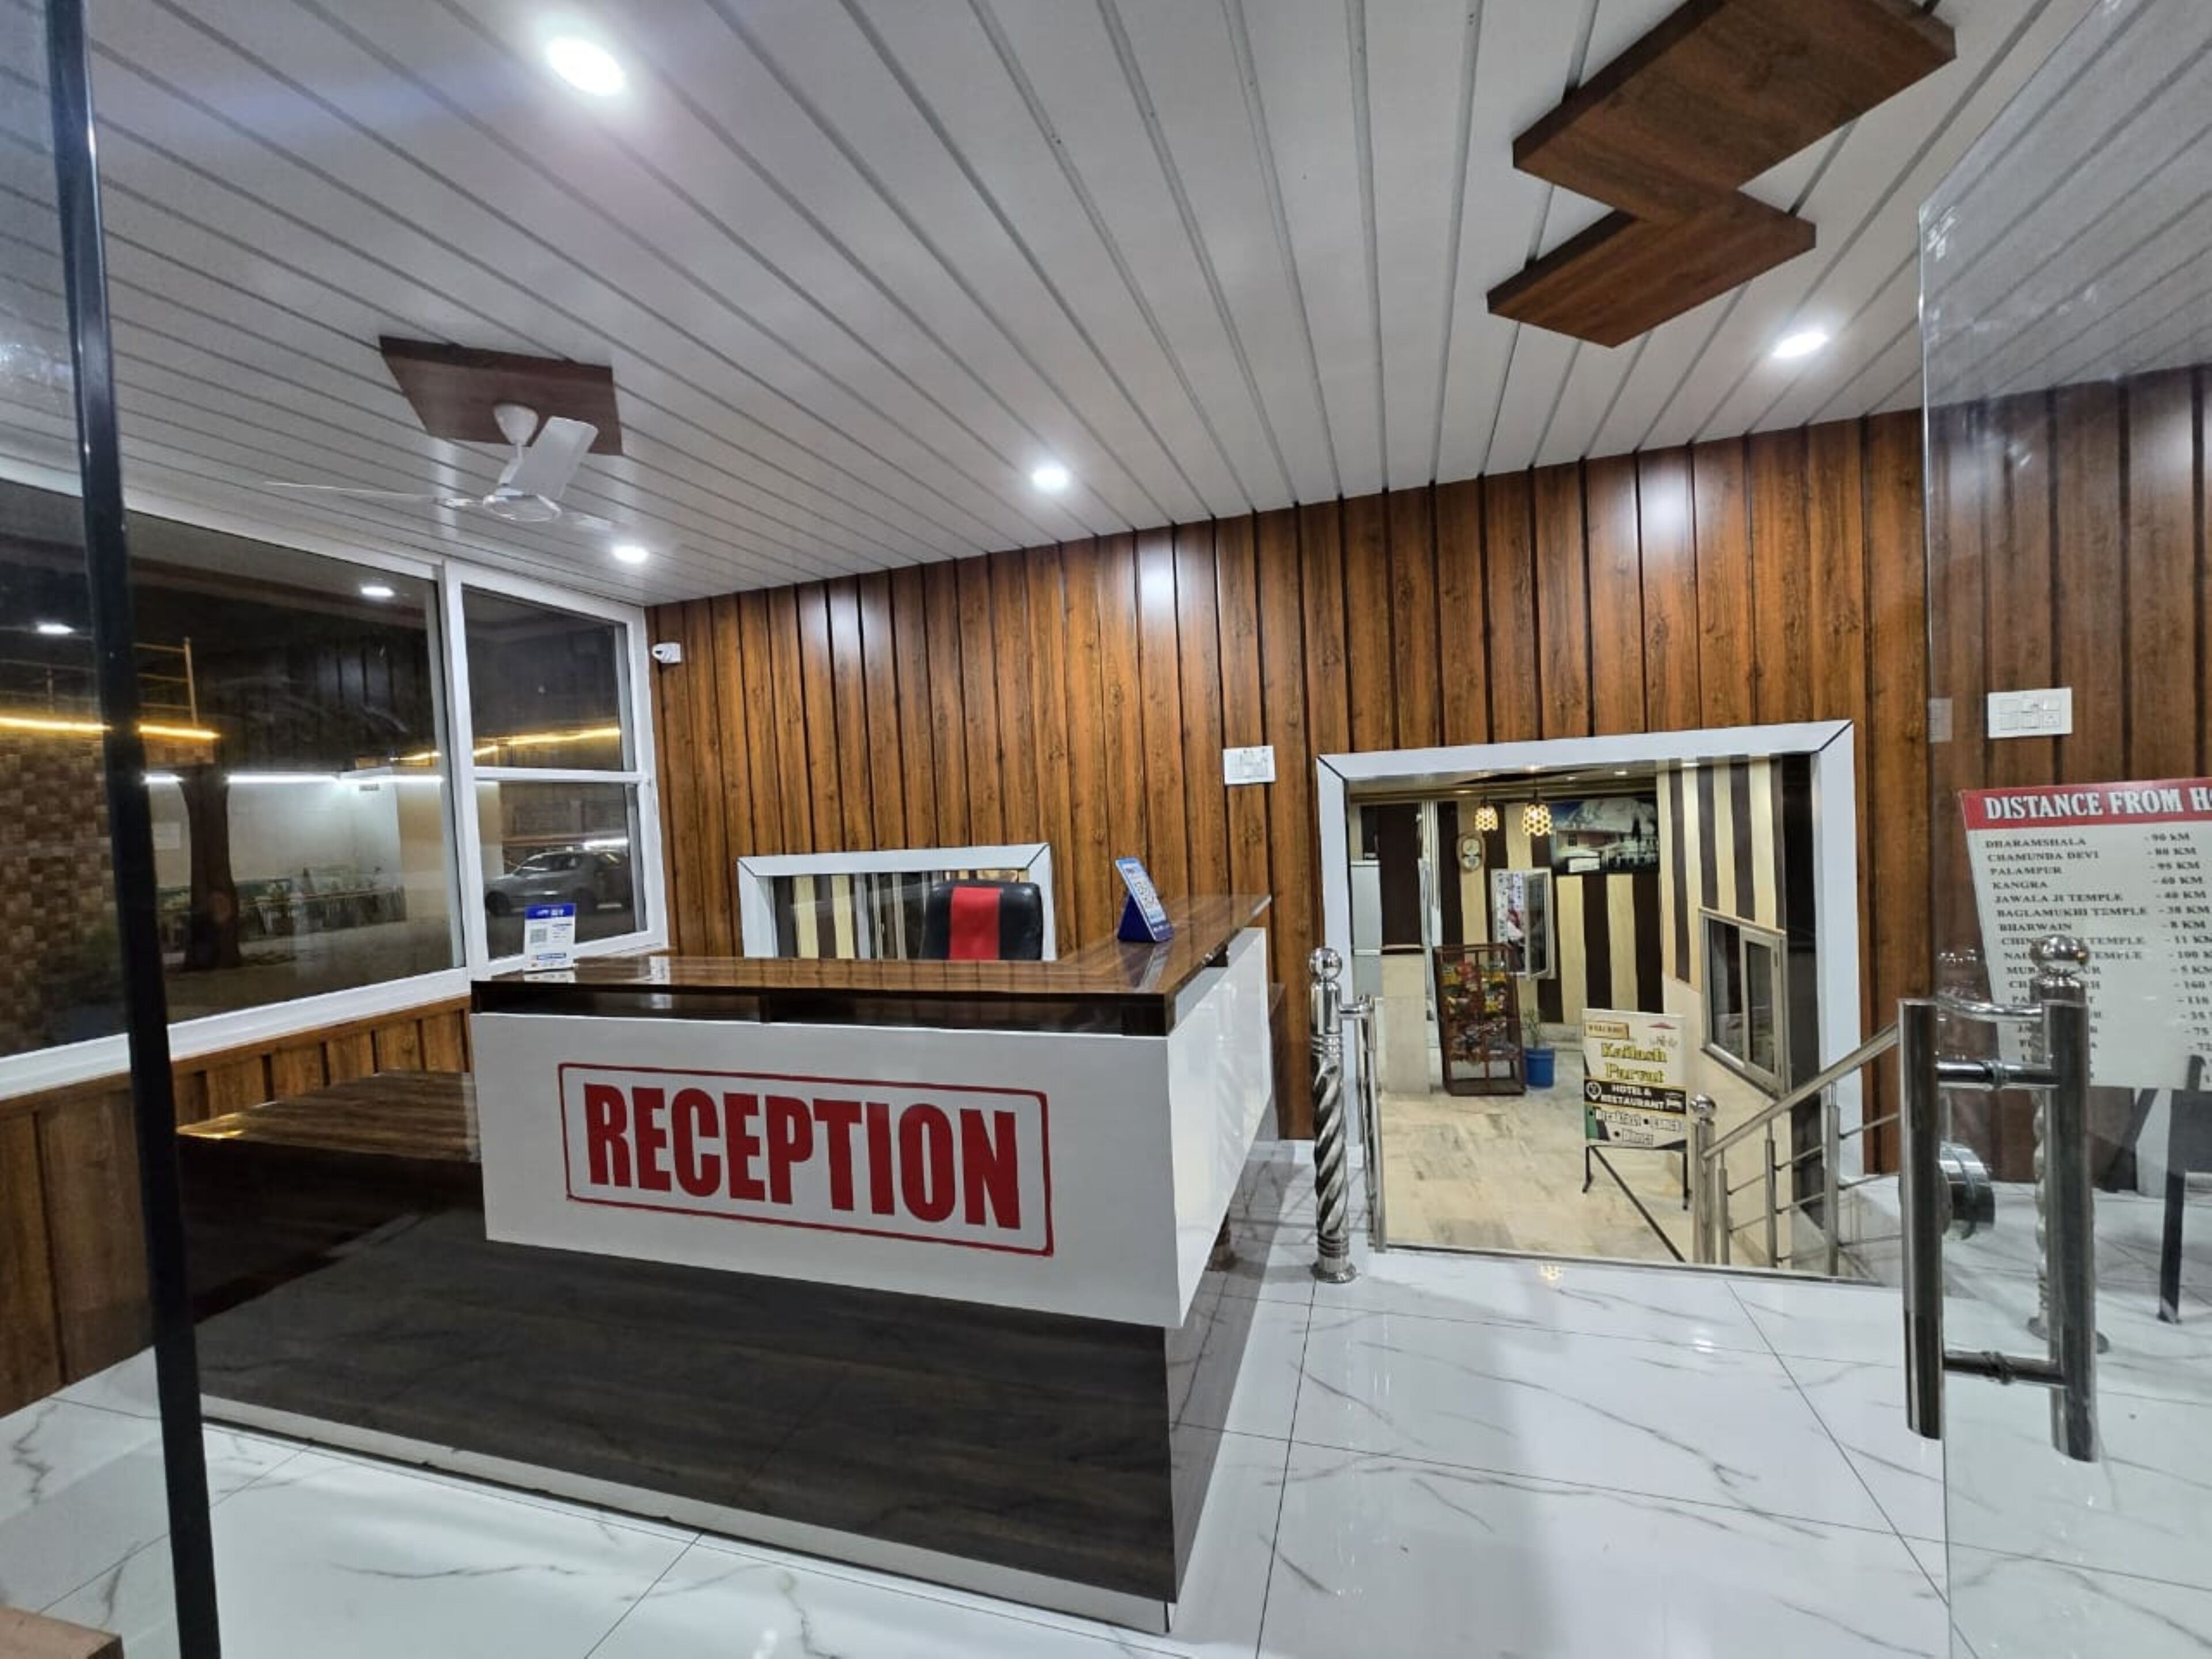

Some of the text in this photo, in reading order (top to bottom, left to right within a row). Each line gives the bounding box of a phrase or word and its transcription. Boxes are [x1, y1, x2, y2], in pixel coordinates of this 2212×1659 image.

[1984, 786, 2212, 819] DISTANCE FROM H
[2067, 850, 2099, 859] DEVI
[2173, 847, 2197, 855] KM
[1990, 866, 2062, 875] PALAMPUR
[2176, 861, 2200, 870] KM
[1993, 880, 2048, 890] KANGRA
[2179, 876, 2203, 885] KM
[2066, 893, 2123, 902] TEMPLE
[2183, 891, 2207, 899] KM
[2089, 906, 2147, 916] TEMPLE
[2186, 906, 2210, 914] KM
[2181, 921, 2206, 929] KM
[2086, 937, 2146, 945] TEMPLE
[1611, 1084, 1642, 1096] HOTEL
[1601, 1094, 1665, 1111] RESTAURANT
[582, 1082, 1022, 1231] RECEPTION
